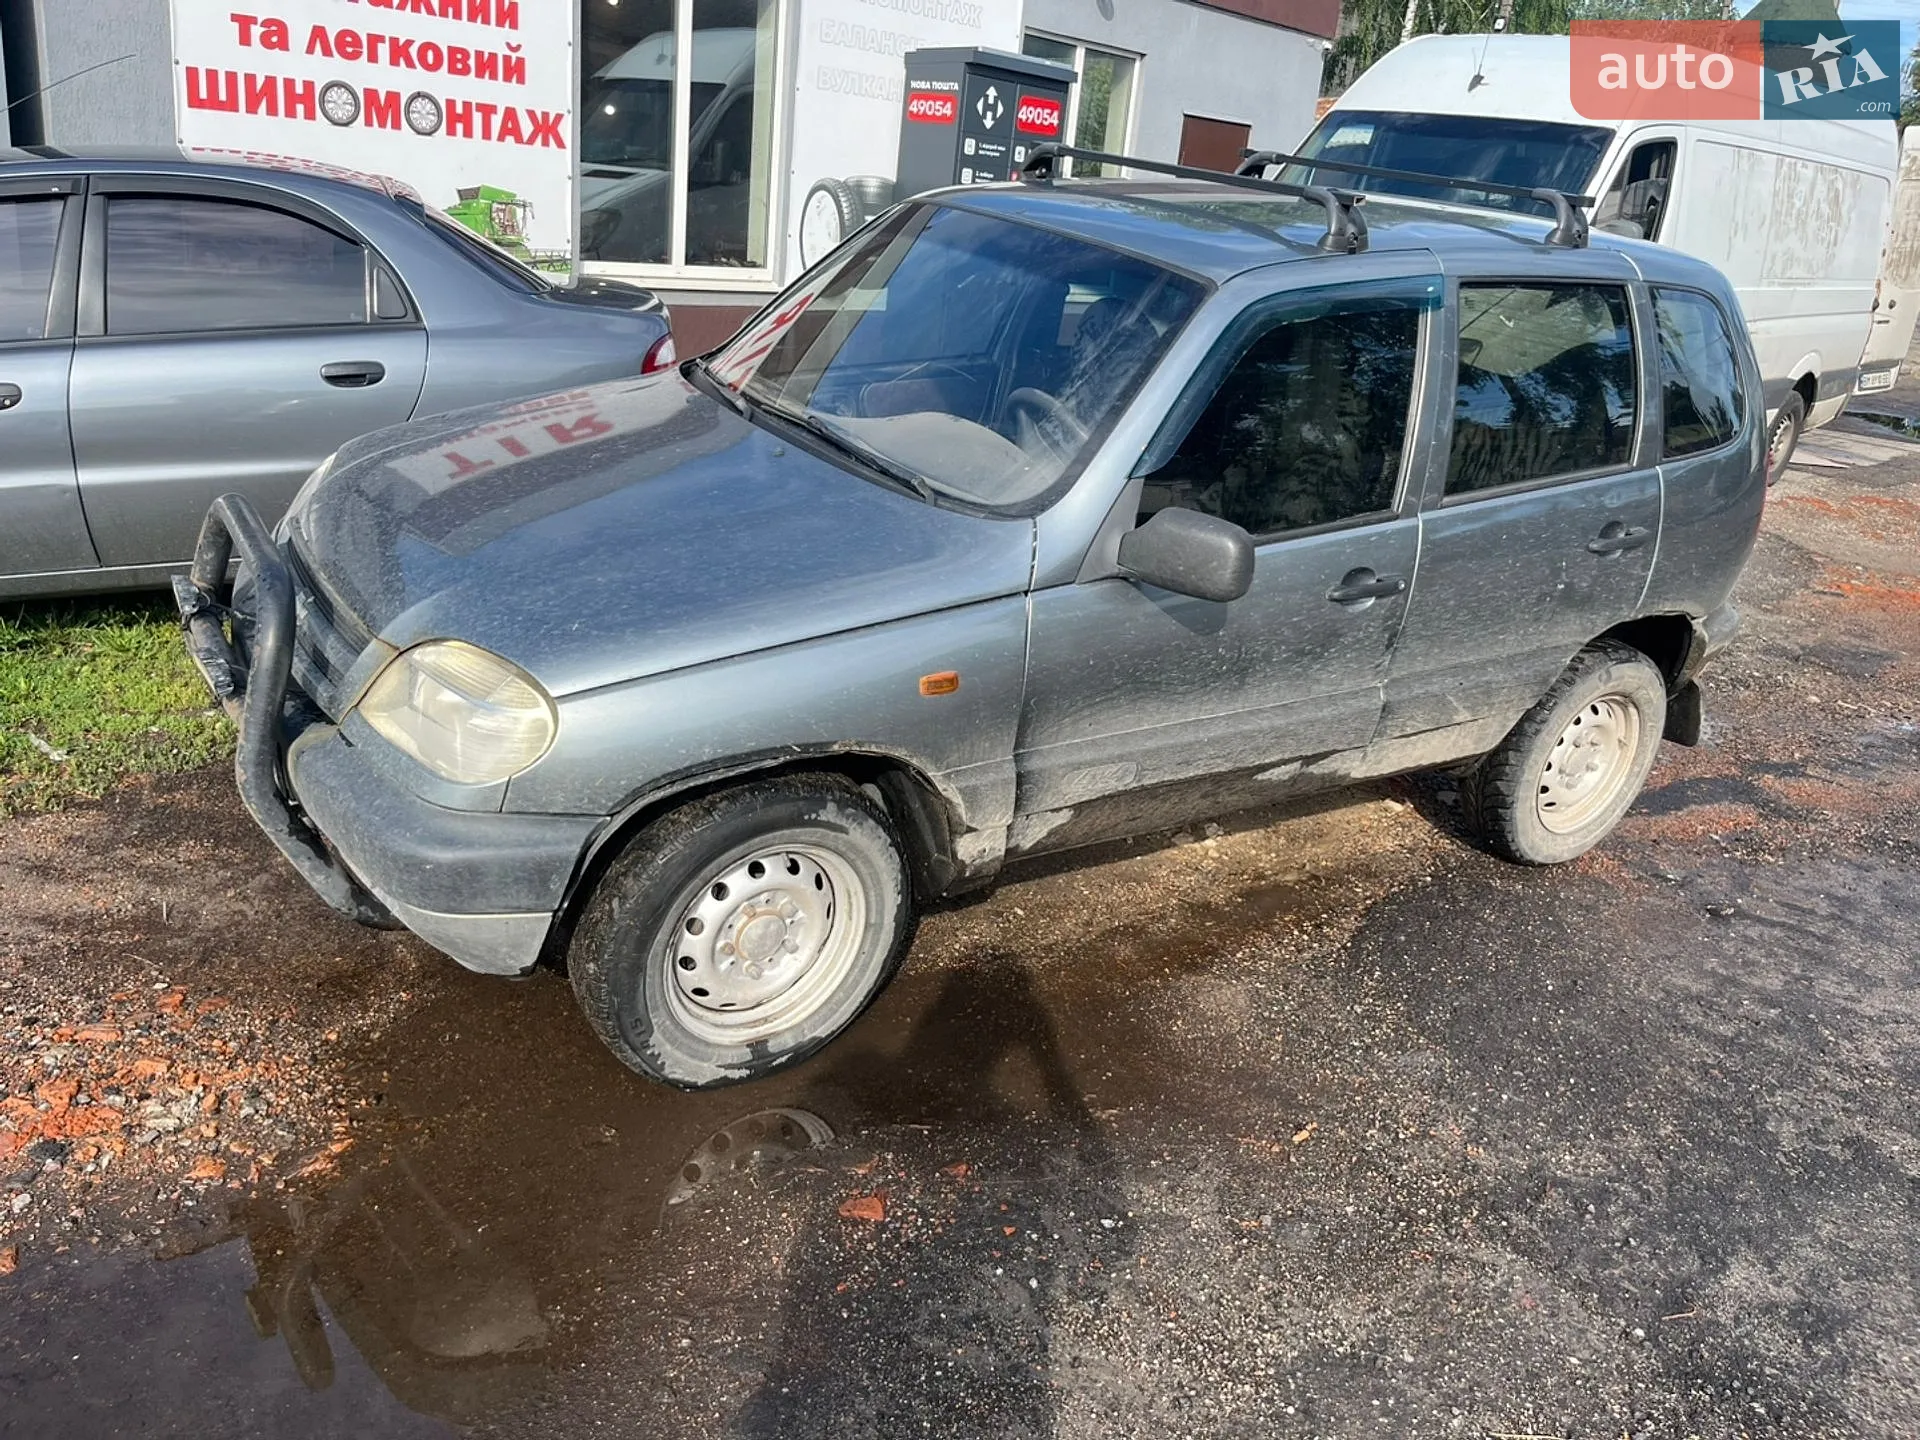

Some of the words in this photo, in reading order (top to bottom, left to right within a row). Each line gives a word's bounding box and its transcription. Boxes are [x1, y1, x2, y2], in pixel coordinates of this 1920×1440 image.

[230, 13, 290, 52] та
[305, 25, 526, 86] легковий
[910, 80, 931, 89] НОВА
[931, 81, 959, 91] ПОШТА
[908, 99, 953, 117] 49054
[1018, 105, 1059, 127] 49054
